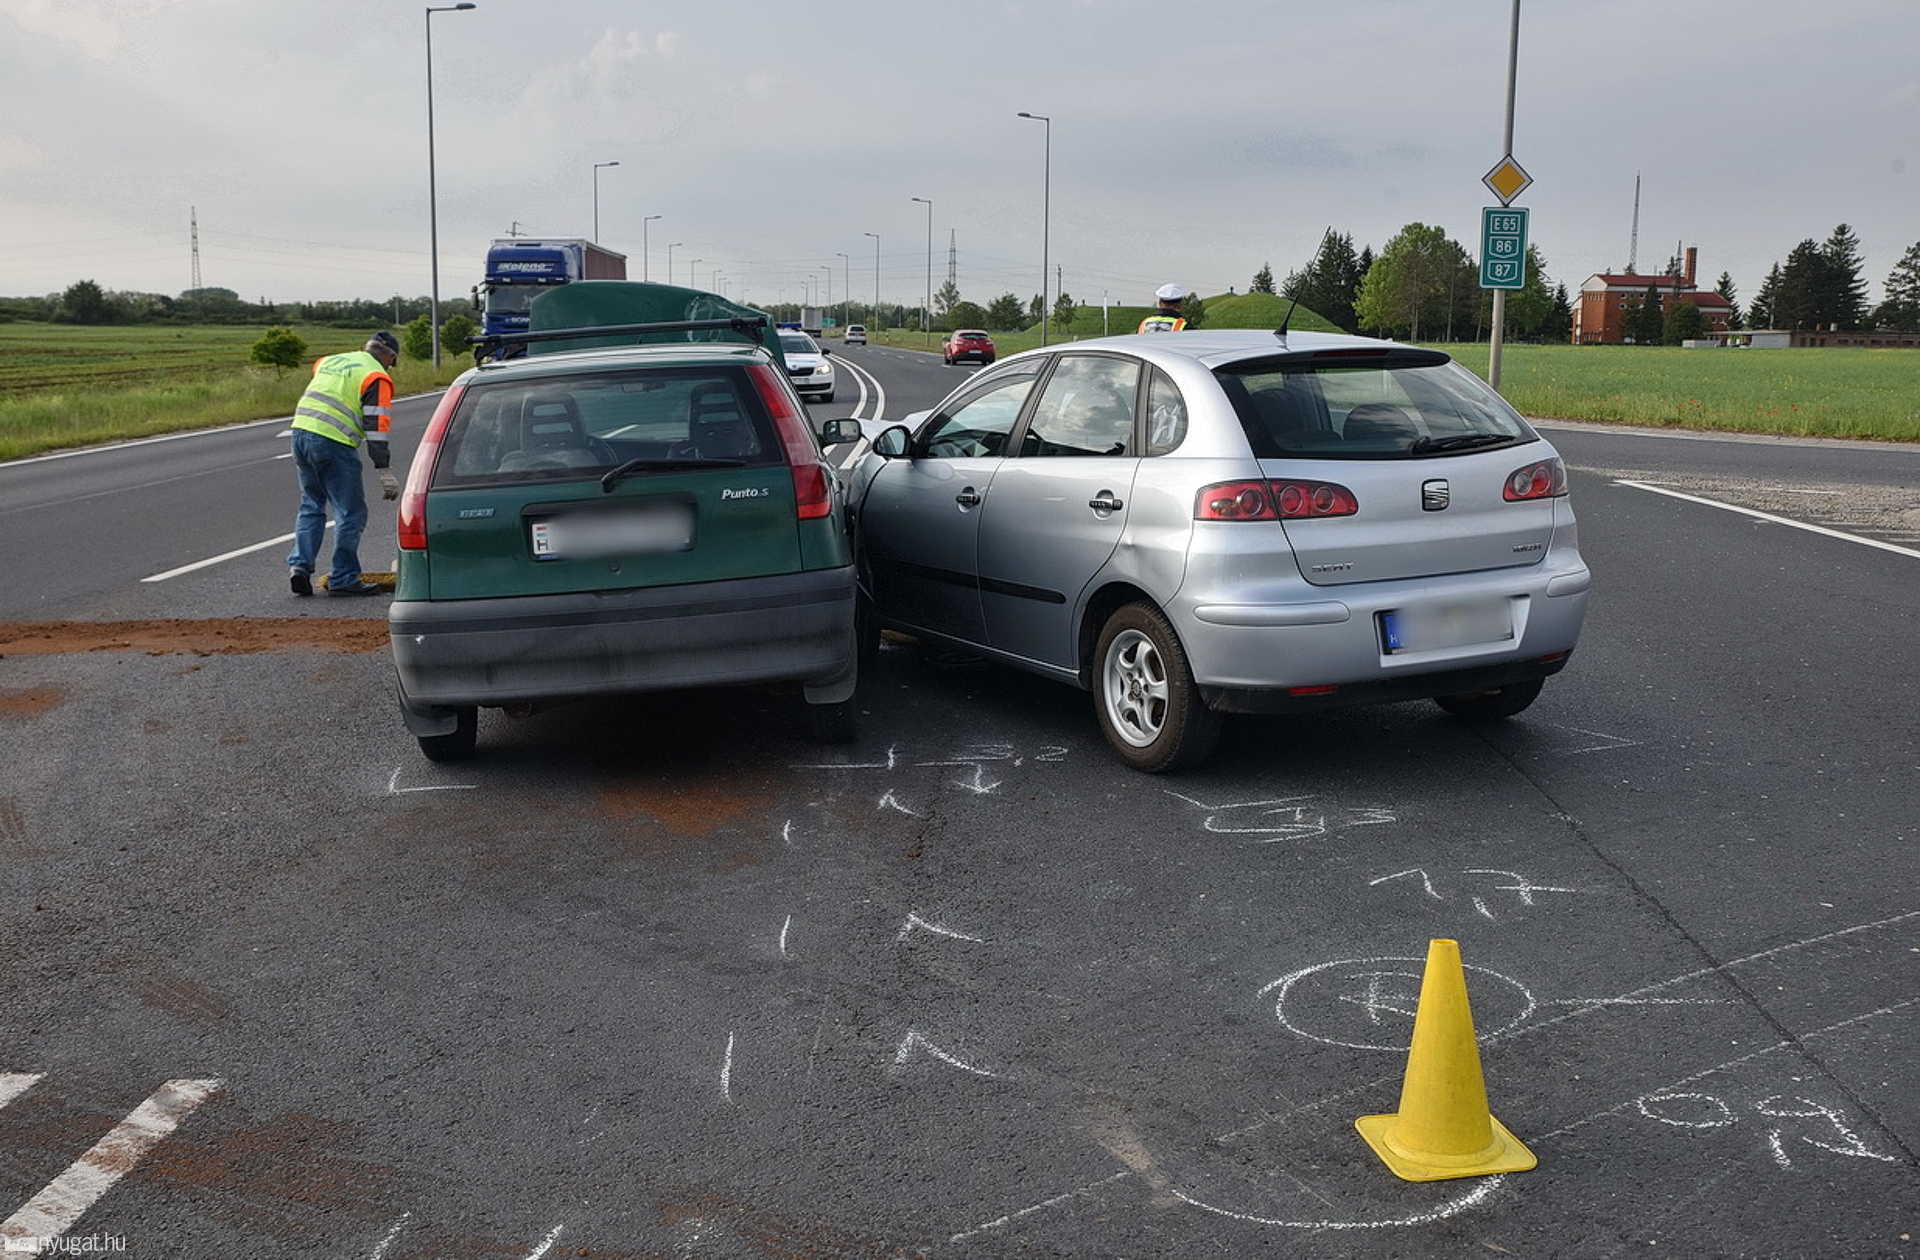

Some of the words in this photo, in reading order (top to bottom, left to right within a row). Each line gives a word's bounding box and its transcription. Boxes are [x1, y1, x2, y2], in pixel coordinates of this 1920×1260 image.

[1494, 217, 1501, 231] E
[1503, 217, 1516, 231] 65
[1496, 240, 1511, 253] 86
[1495, 263, 1511, 277] 87
[721, 487, 758, 500] Punto
